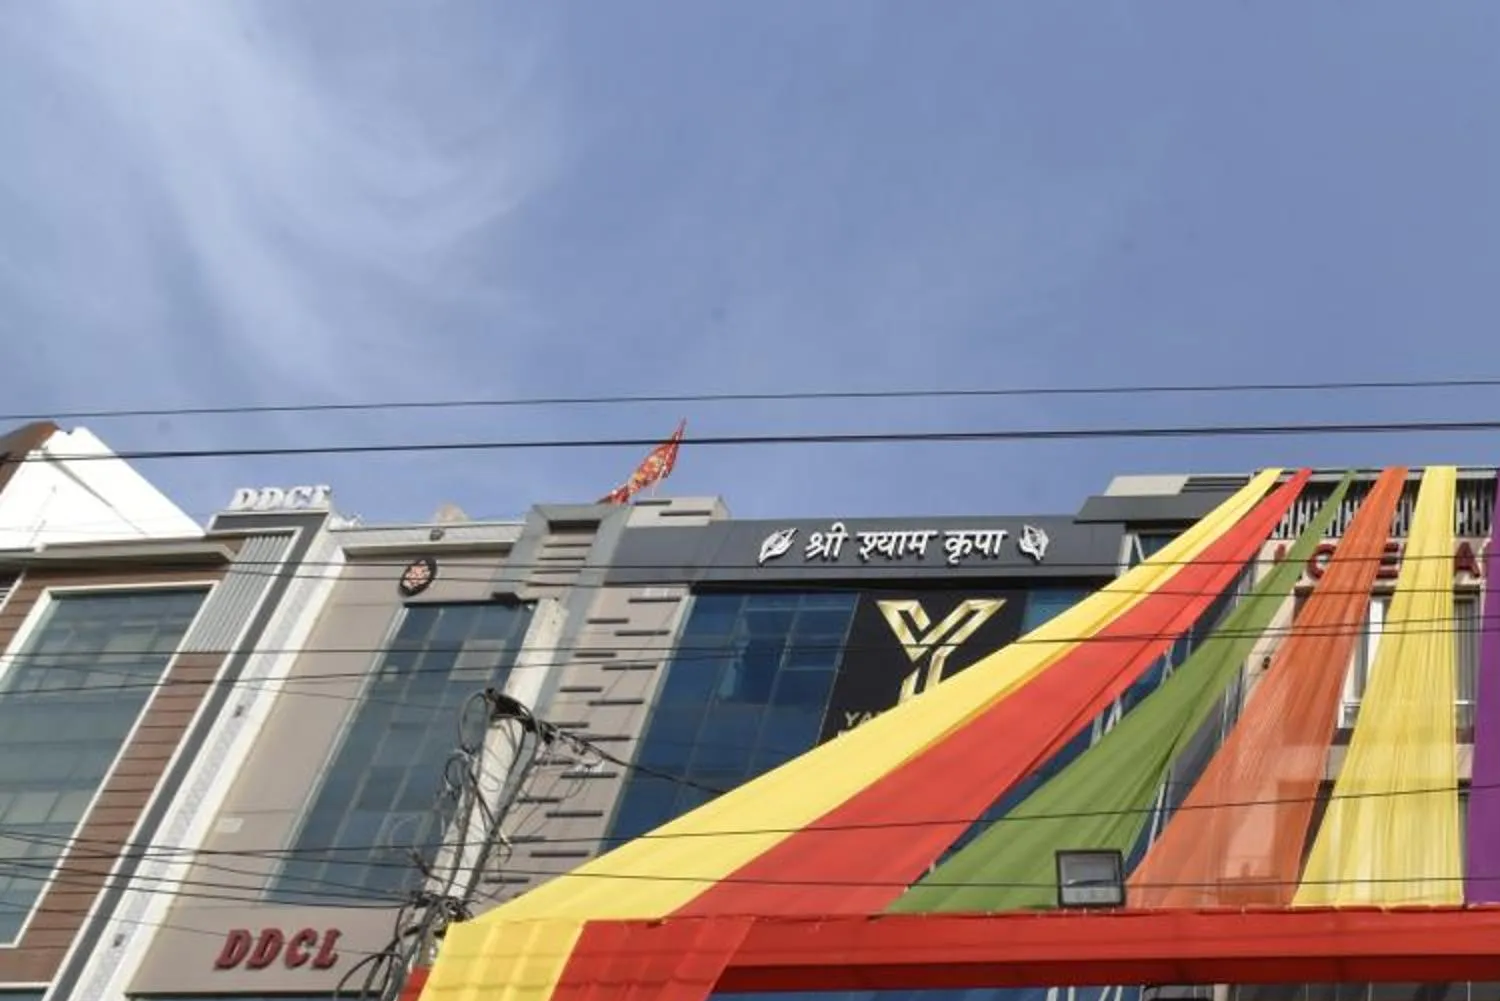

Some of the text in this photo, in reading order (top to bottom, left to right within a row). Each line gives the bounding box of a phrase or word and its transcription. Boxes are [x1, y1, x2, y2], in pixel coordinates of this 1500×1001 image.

[806, 522, 1008, 563] श्री श्याम कृपा
[213, 928, 342, 970] DDCL
